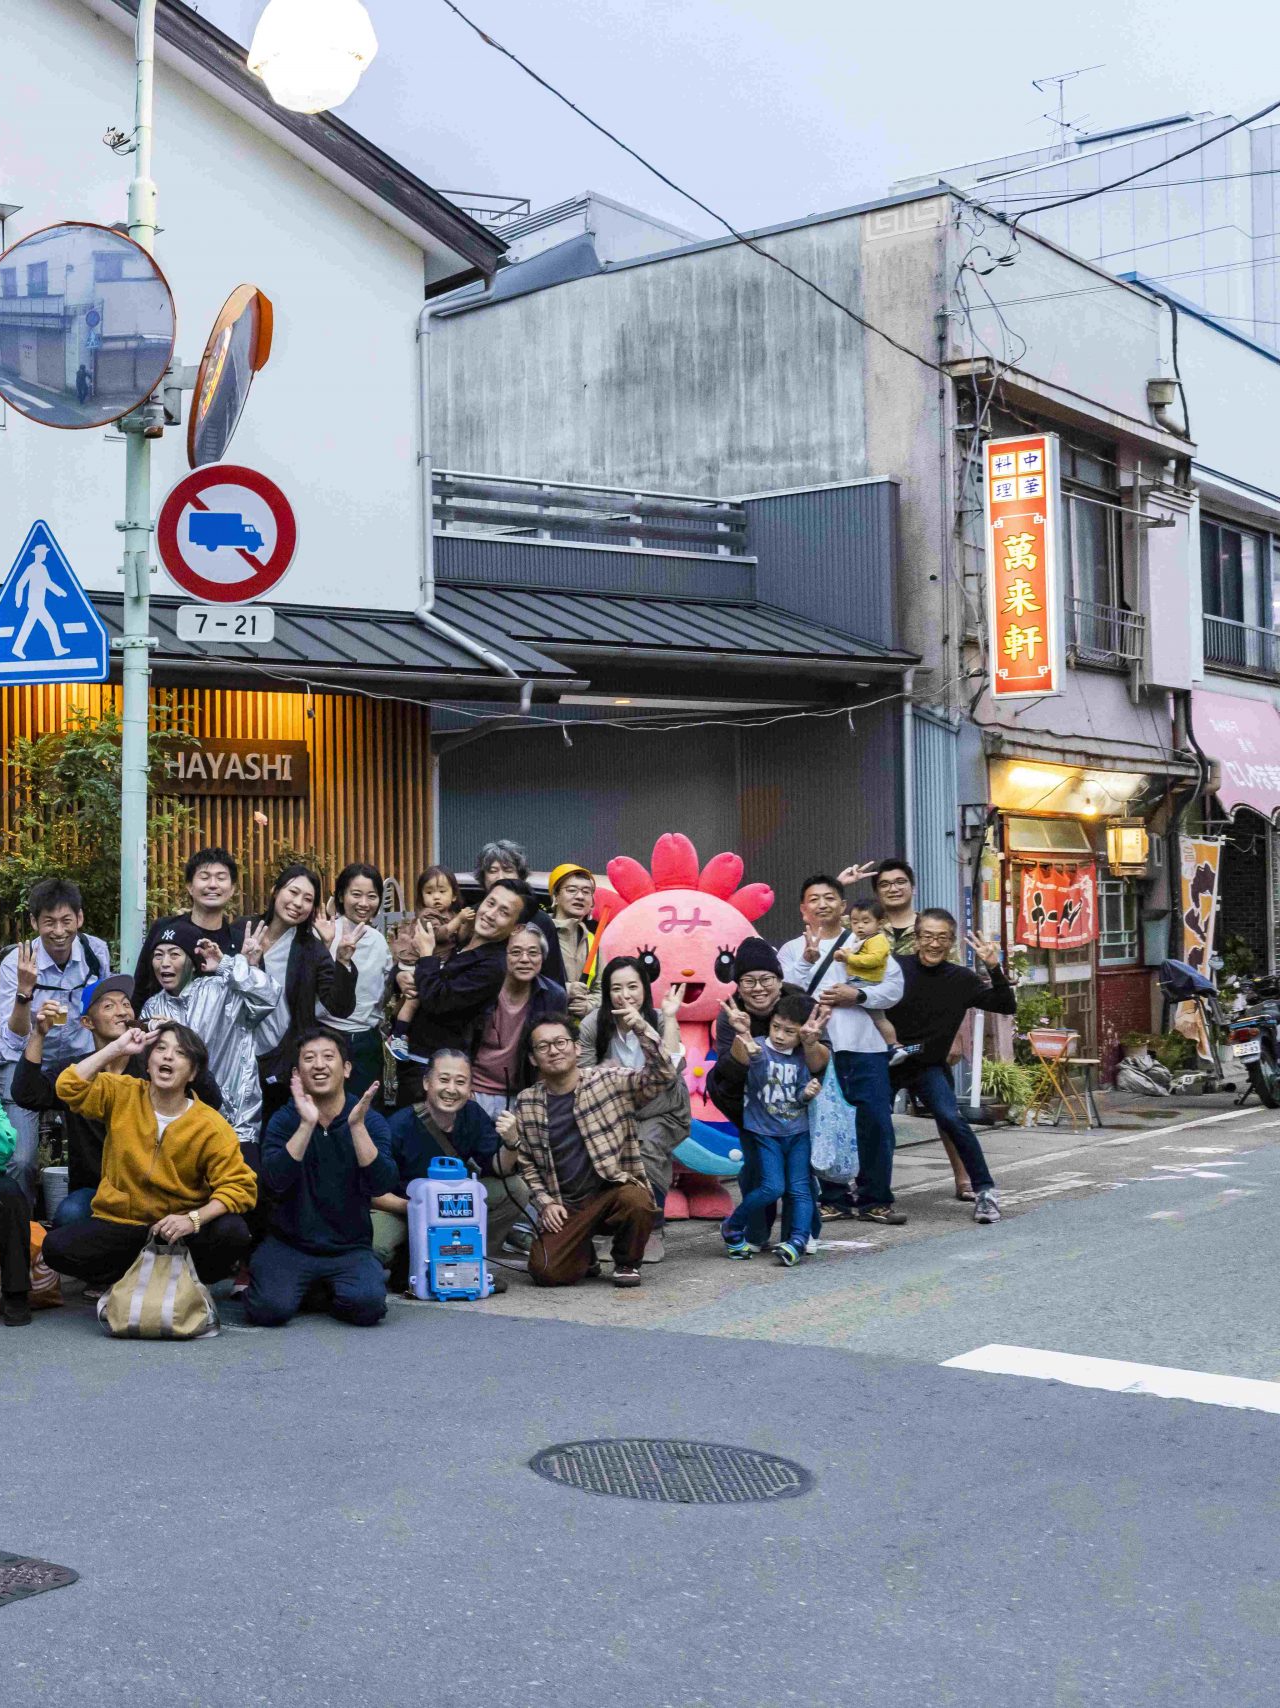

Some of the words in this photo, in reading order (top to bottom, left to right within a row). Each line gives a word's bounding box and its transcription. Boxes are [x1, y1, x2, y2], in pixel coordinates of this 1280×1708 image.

[1001, 532, 1044, 661] 萬来軒
[165, 752, 293, 780] HAYASHI
[658, 905, 713, 934] み
[161, 929, 176, 940] NY
